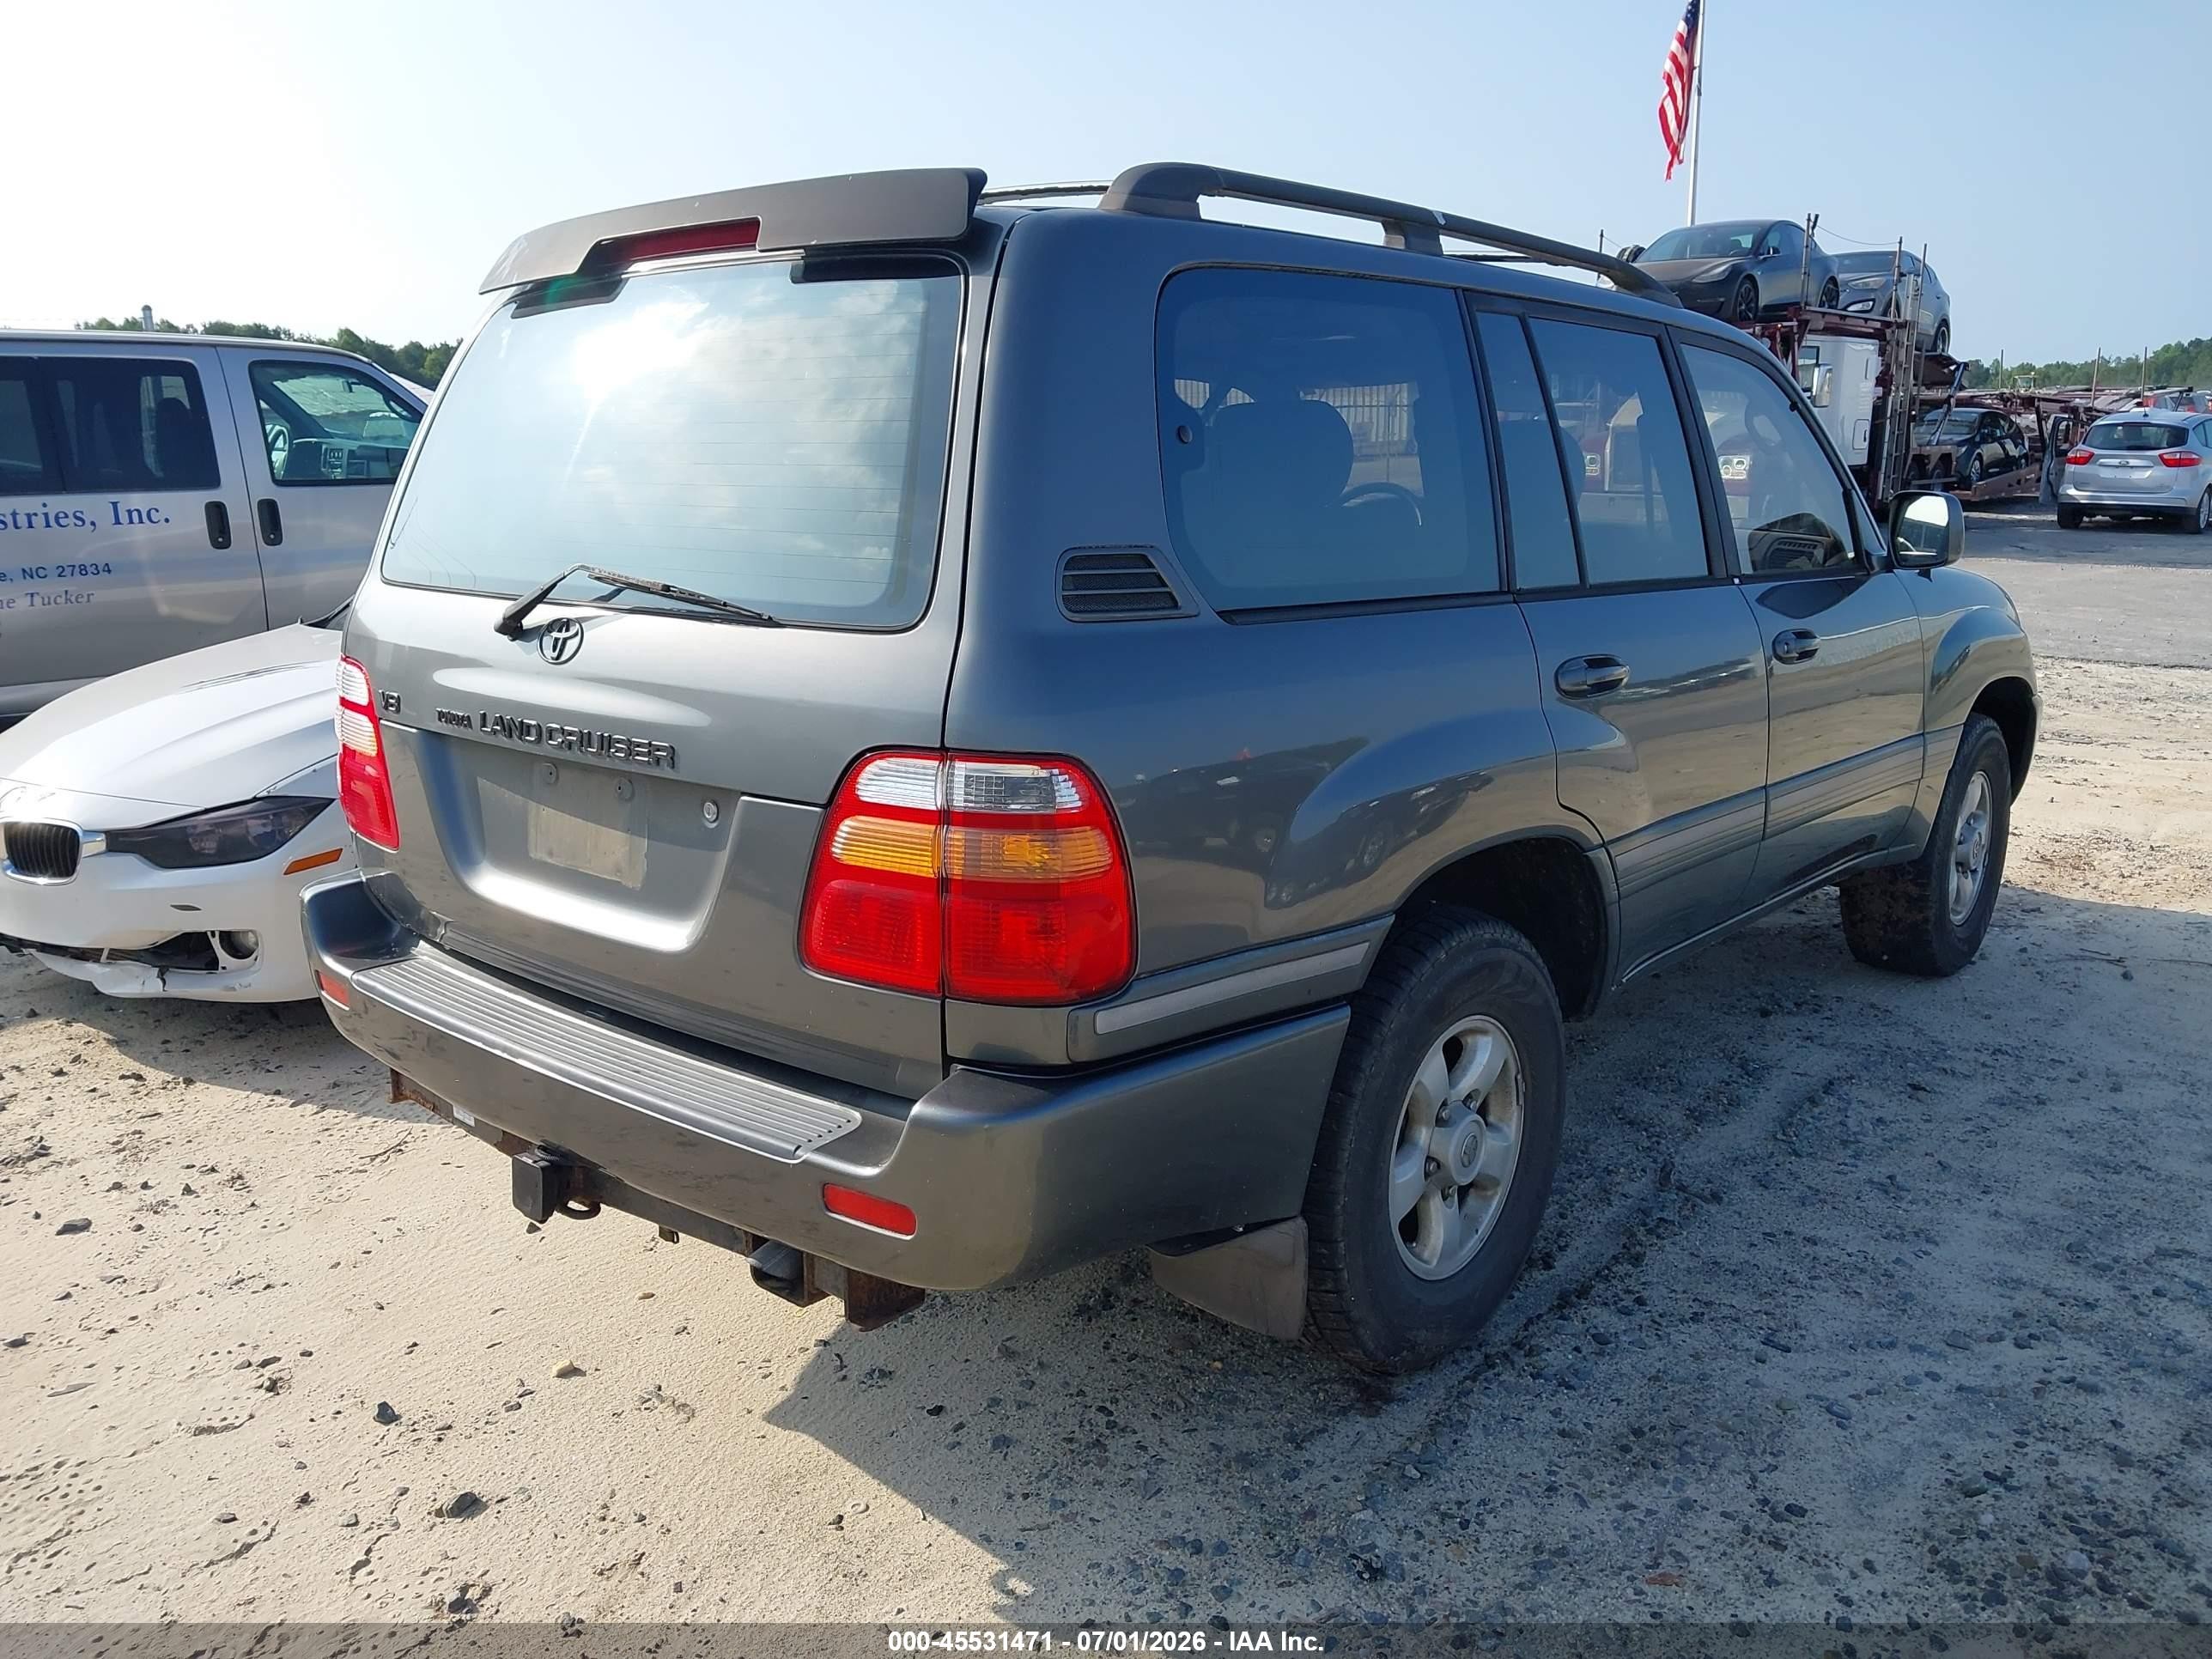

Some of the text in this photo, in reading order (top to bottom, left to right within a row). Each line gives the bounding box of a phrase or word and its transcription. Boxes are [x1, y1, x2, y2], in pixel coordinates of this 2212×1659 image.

[108, 500, 170, 526] Inc.
[21, 566, 48, 580] NC
[56, 562, 112, 579] 27834
[25, 589, 95, 609] Tucker
[378, 689, 402, 714] V8
[478, 709, 543, 744] LAND
[544, 722, 676, 769] CRUISER
